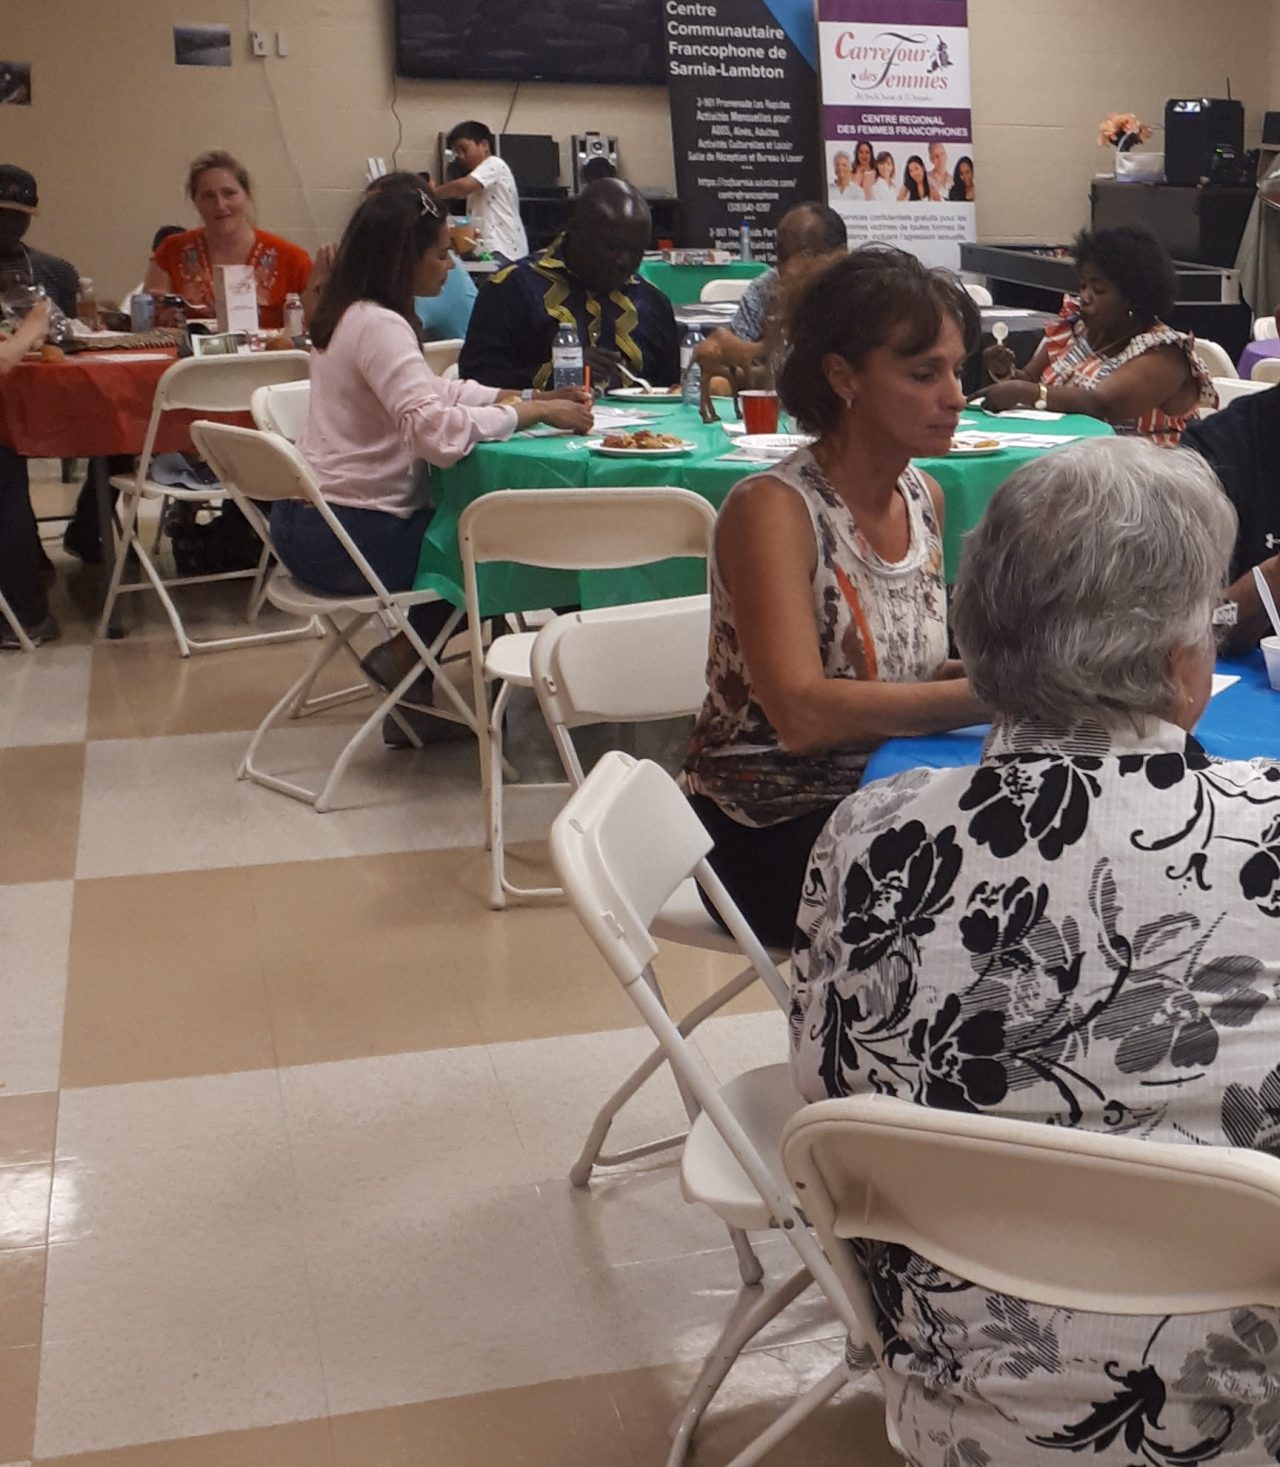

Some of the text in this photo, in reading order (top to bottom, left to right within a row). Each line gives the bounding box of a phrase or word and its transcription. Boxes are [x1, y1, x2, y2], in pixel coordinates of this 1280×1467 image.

[666, 1, 716, 16] Centre
[667, 21, 784, 39] Communautaire
[668, 41, 787, 59] Francophone de
[834, 31, 931, 63] Carrefour
[669, 61, 784, 78] Sarnia-Lambton
[859, 68, 877, 82] des
[861, 113, 944, 125] CENTRE REGIONAL
[837, 124, 968, 137] DES FEMMES FRANCOPHONES
